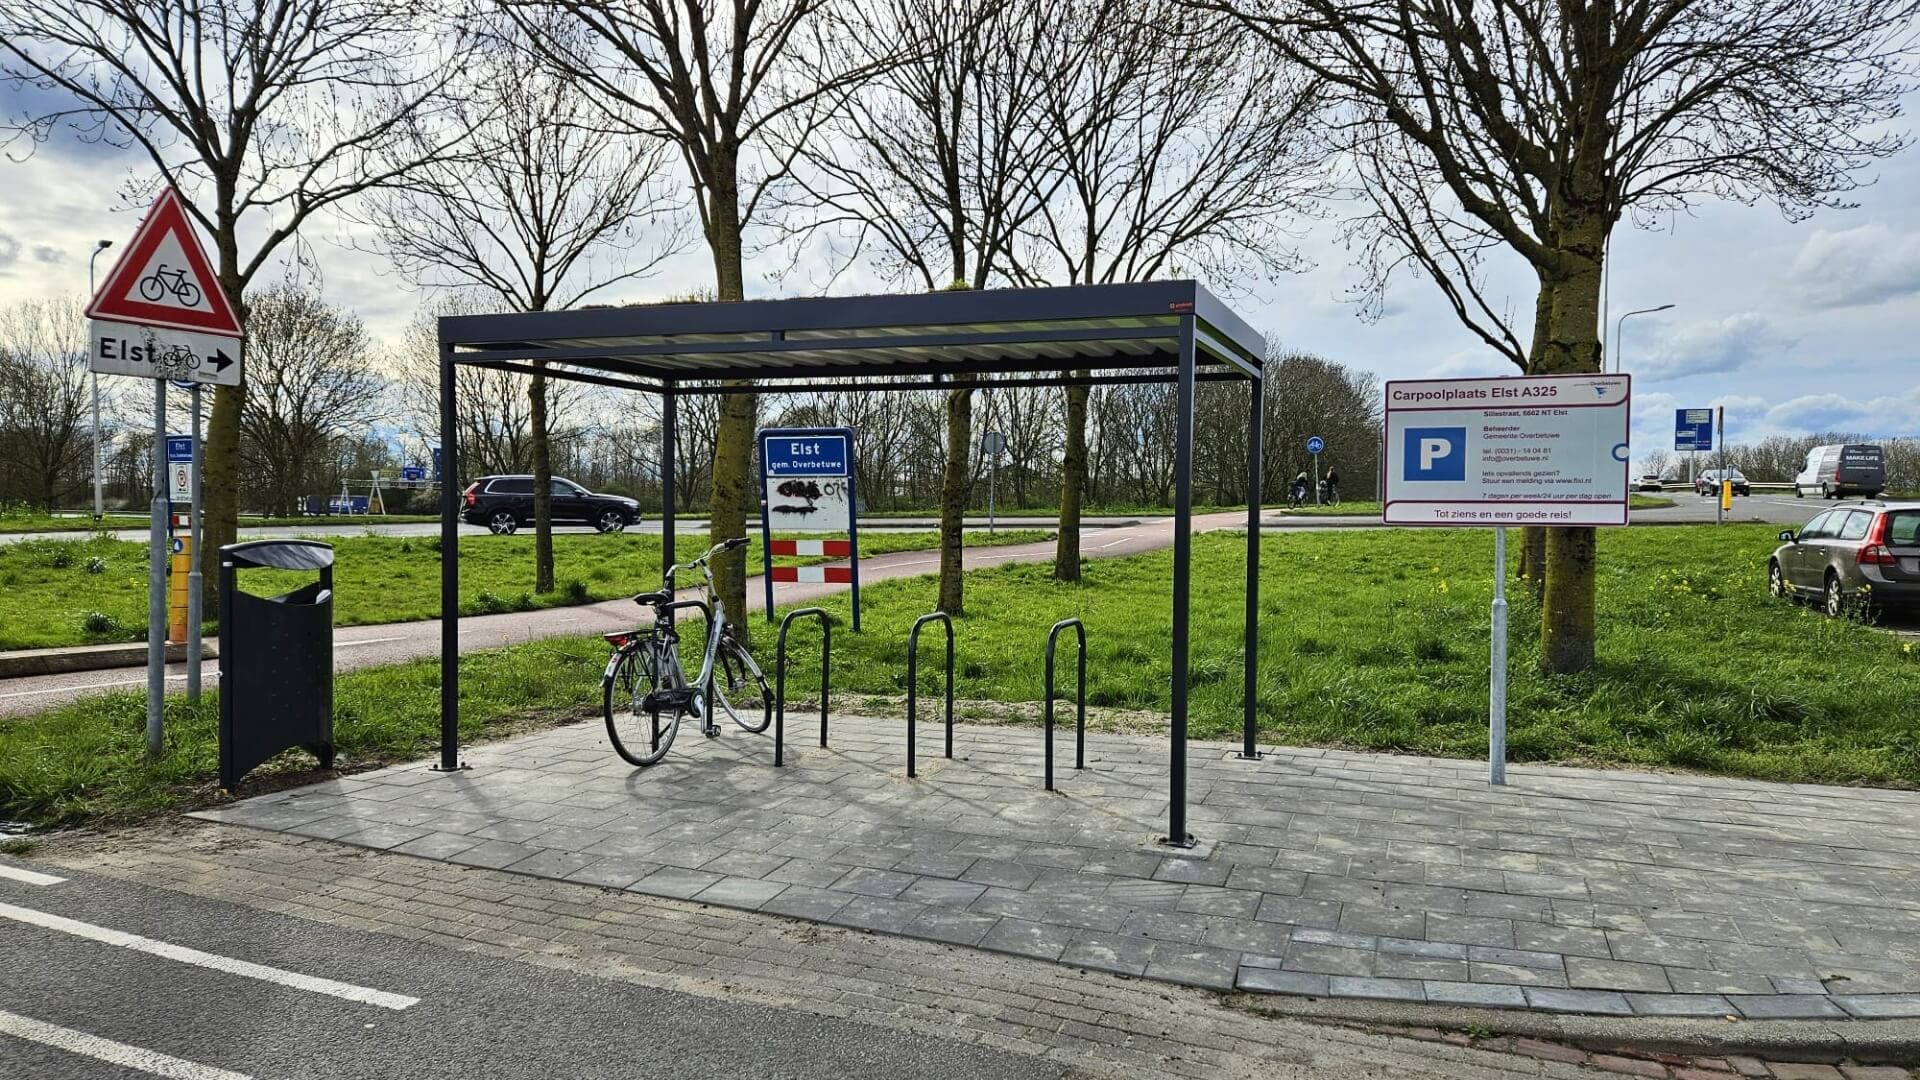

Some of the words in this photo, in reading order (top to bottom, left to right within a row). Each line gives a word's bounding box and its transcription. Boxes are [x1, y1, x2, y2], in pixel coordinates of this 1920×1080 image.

[99, 336, 157, 364] Elst
[1392, 389, 1487, 402] Carpoolplaats
[1491, 386, 1519, 398] Elst
[1521, 386, 1558, 398] A325
[791, 442, 820, 455] Elst
[1420, 438, 1452, 470] P
[1434, 510, 1449, 518] Tot
[1451, 510, 1477, 518] ziens
[1515, 511, 1547, 520] goede
[1549, 510, 1572, 518] reis!
